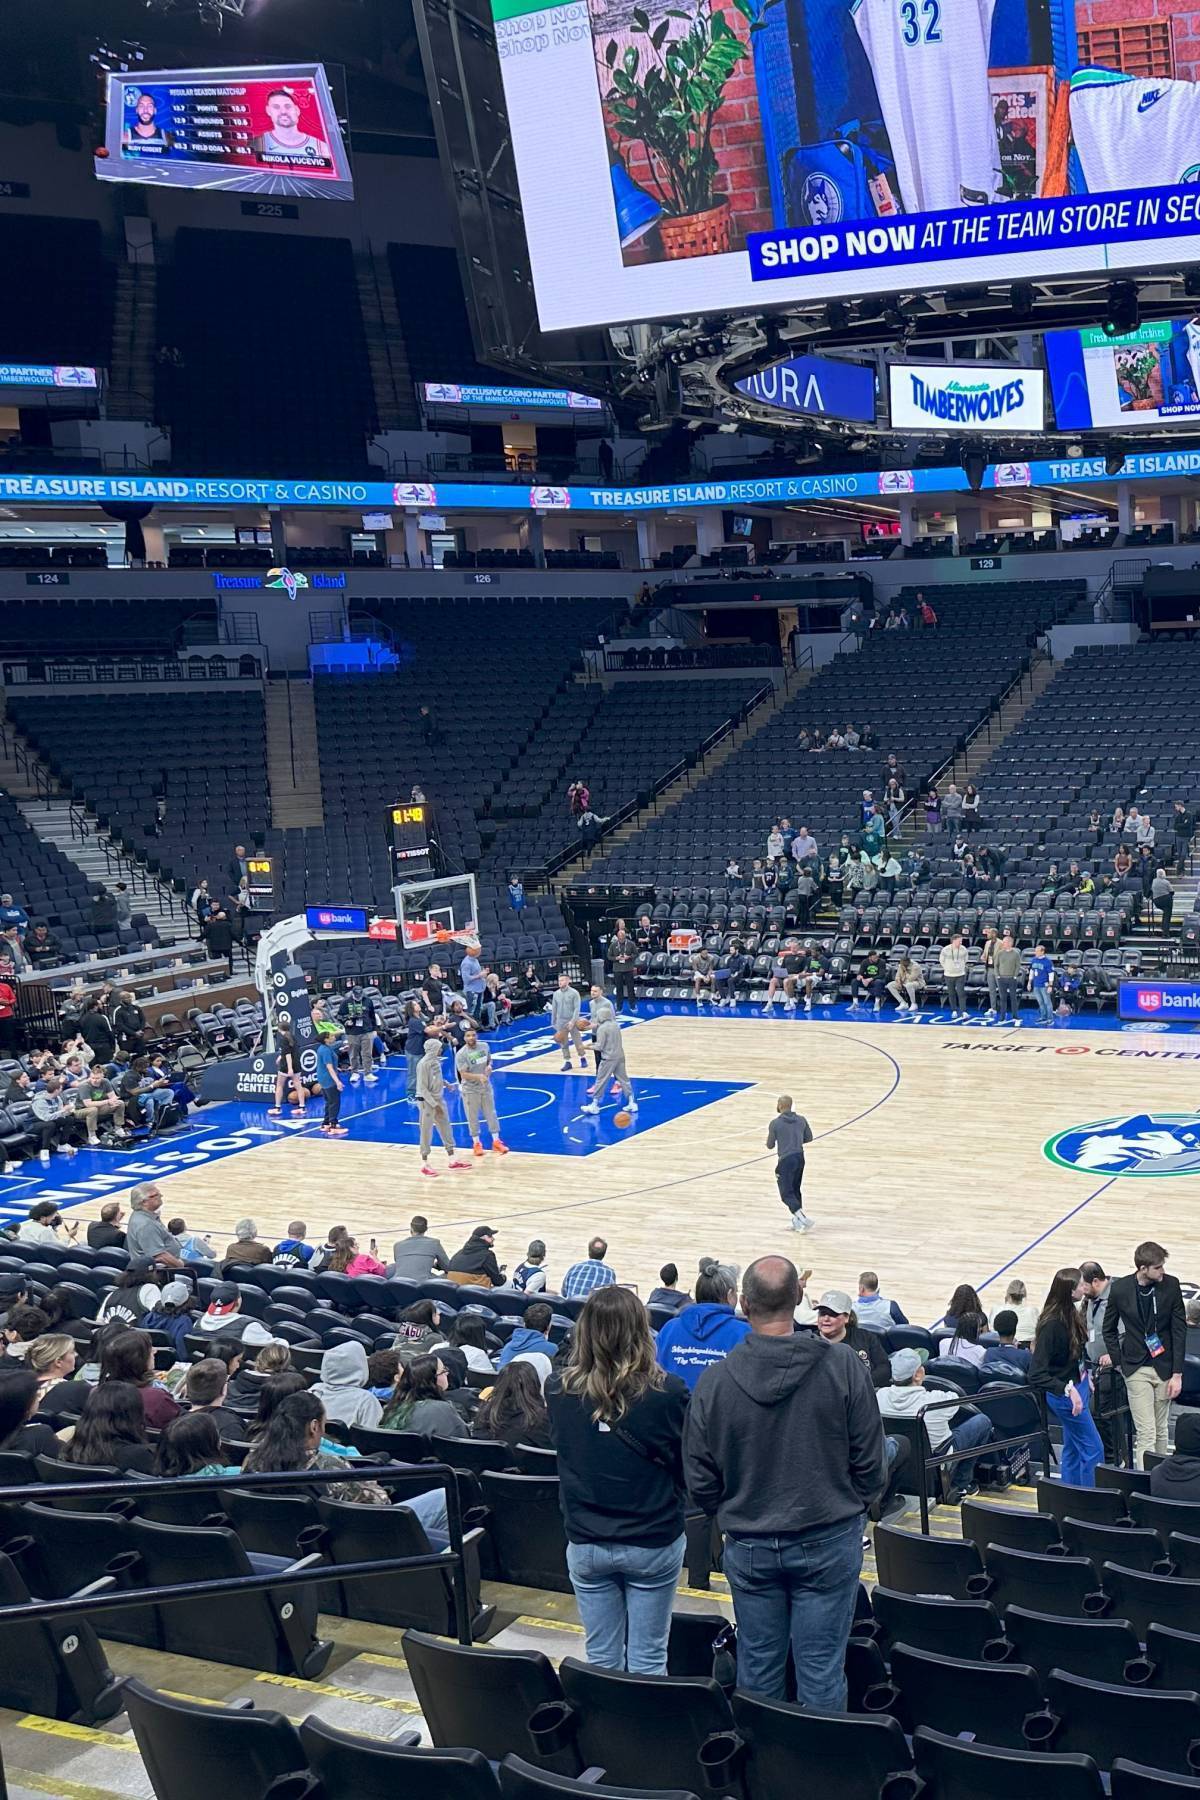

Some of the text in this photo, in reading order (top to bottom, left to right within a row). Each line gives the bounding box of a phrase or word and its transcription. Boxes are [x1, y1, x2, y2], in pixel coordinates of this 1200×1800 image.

[496, 13, 547, 38] Shop
[900, 0, 943, 46] 32
[498, 34, 549, 58] Shop
[218, 88, 246, 96] MATCHUP
[1142, 89, 1161, 103] NIKE
[263, 155, 325, 166] NIKOLA VUCEVIC
[257, 203, 282, 216] 225
[761, 235, 840, 267] SHOP
[846, 225, 916, 259] NOW
[920, 222, 947, 249] AT
[952, 218, 990, 246] THE
[996, 211, 1056, 242] TEAM
[1060, 201, 1132, 236] STORE
[1136, 199, 1160, 226] IN
[10, 368, 53, 377] PARTNER
[461, 388, 502, 397] EXCLUSIVE
[503, 389, 530, 398] CASINO
[533, 391, 566, 399] PARTNER
[910, 372, 1024, 423] TIMBERWOLVES
[1161, 405, 1183, 414] SHOP
[1139, 454, 1200, 475] ISLAND
[0, 478, 366, 500] TREASURE ISLAND RESORT & CASINO
[590, 477, 858, 506] TREASURE ISLAND RESORT & CASINO
[978, 560, 994, 570] 129
[38, 575, 59, 584] 124
[212, 572, 346, 590] Treasure Island
[475, 575, 491, 583] 126
[406, 848, 430, 857] TISSOT
[332, 913, 352, 923] bank
[1140, 993, 1160, 1006] us
[940, 1042, 1055, 1053] TARGET
[238, 1073, 276, 1084] TARGET
[237, 1083, 276, 1094] CENTER
